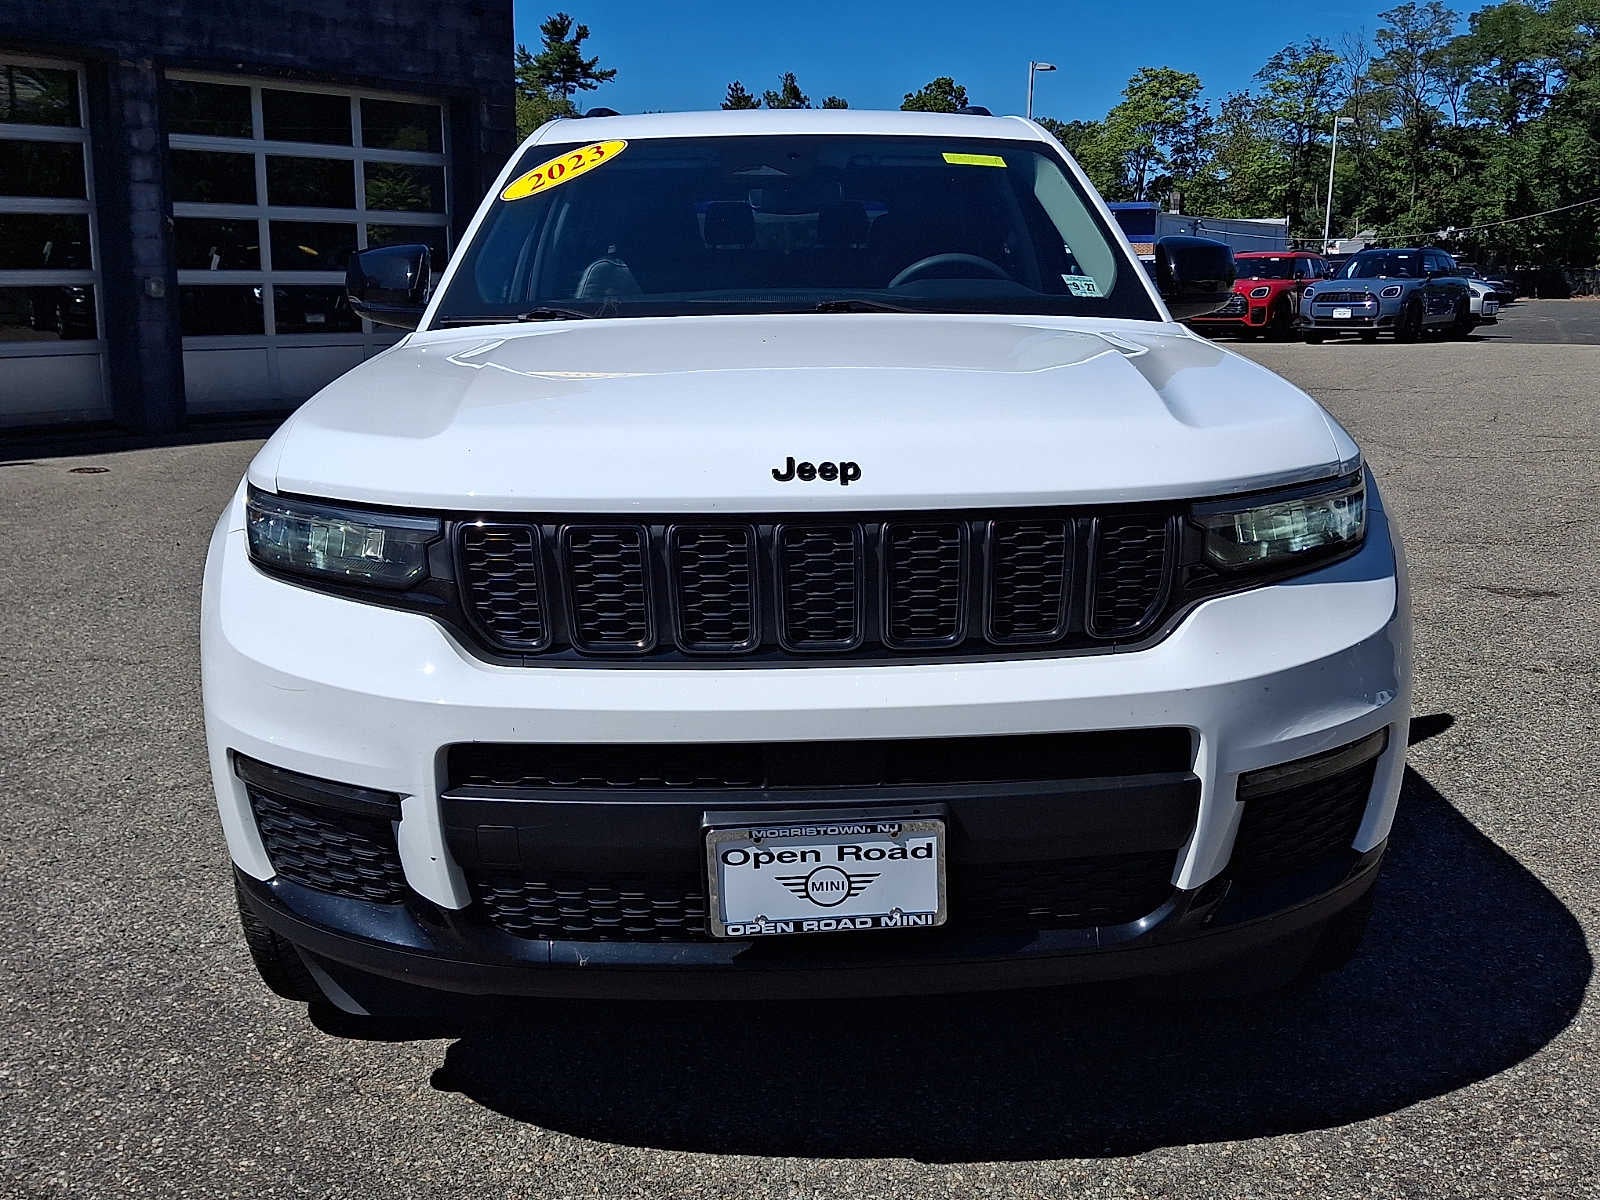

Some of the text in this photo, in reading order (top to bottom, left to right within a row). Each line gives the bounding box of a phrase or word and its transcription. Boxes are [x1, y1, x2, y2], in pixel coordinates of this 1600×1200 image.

[527, 145, 605, 191] 2023
[771, 456, 862, 486] Jeep
[877, 823, 899, 834] NJ
[721, 842, 933, 869] Open Road
[811, 881, 845, 892] MINI
[727, 914, 933, 936] OPEN ROAD MINI
